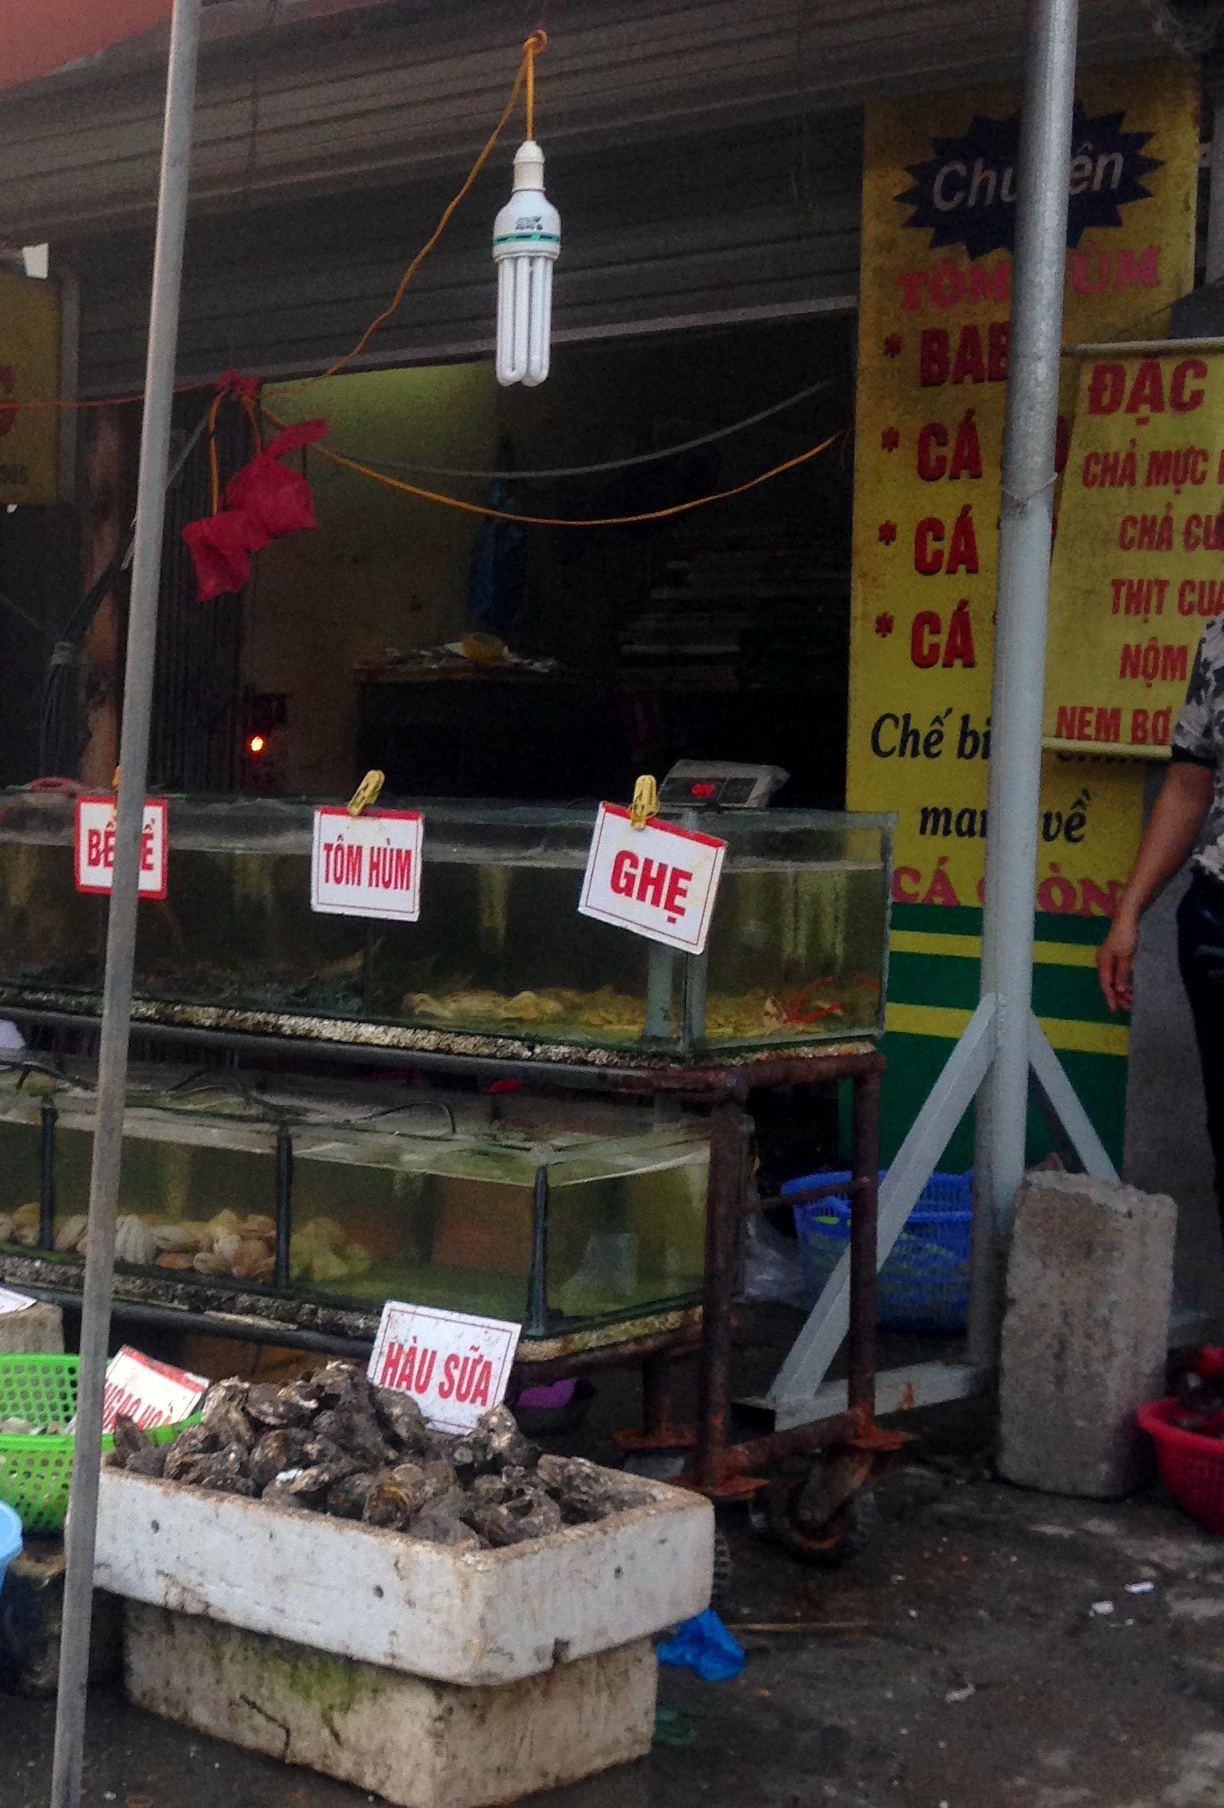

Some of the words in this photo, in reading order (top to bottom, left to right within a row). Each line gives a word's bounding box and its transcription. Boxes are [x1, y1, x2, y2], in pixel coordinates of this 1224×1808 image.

[1066, 242, 1162, 296] ÙM
[916, 407, 984, 483] CÁ
[1082, 437, 1138, 490] CHẢ
[913, 503, 981, 578] CÁ
[1118, 501, 1175, 551] CHẢ
[1111, 577, 1170, 625] THỊT
[910, 597, 977, 671] CÁ
[1118, 636, 1190, 690] NỘM
[871, 707, 955, 759] Chế
[1055, 704, 1122, 743] NEM
[1042, 787, 1092, 844] về
[323, 834, 363, 887] TÔM
[368, 837, 412, 891] HÙM
[609, 849, 693, 924] GHẸ
[438, 1345, 493, 1407] SỮA
